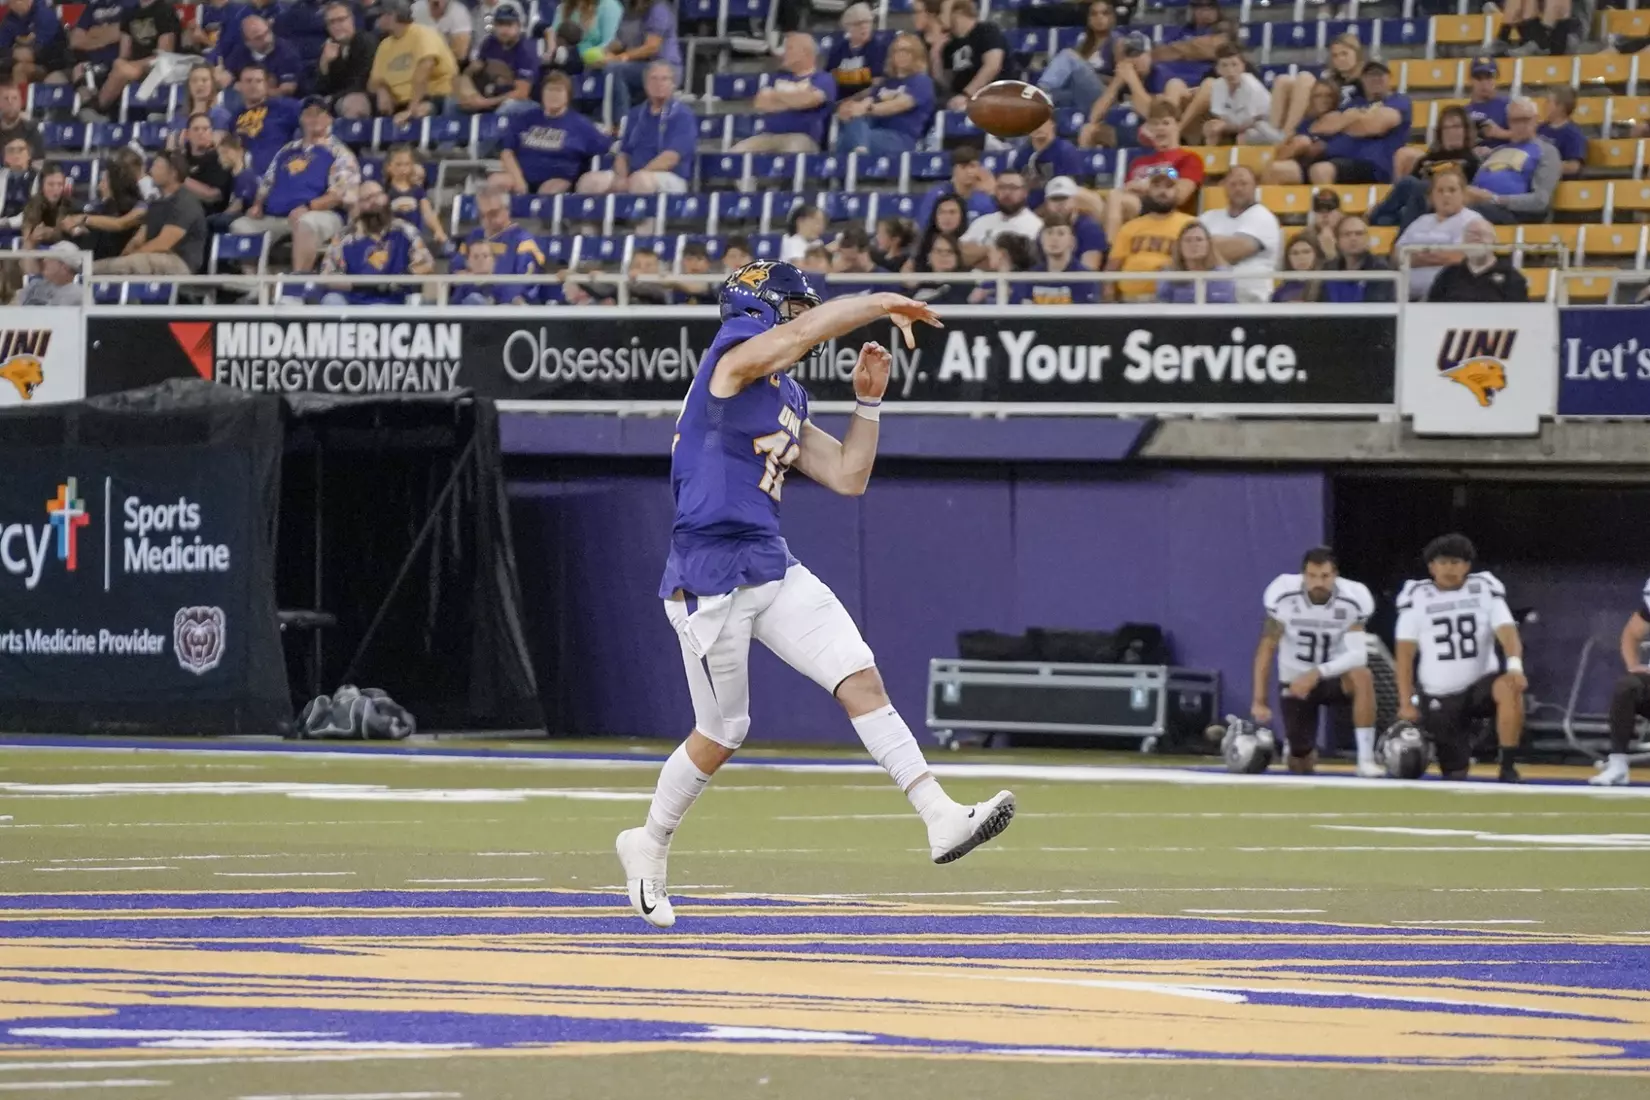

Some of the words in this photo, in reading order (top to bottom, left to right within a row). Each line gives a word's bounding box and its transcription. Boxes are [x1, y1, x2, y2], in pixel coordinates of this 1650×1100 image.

[215, 322, 463, 359] MIDAMERICAN
[938, 330, 991, 381] At
[999, 330, 1111, 382] Your
[1123, 326, 1308, 382] Service.
[1437, 329, 1518, 371] UNI
[216, 360, 314, 391] ENERGY
[323, 360, 462, 392] COMPANY
[123, 495, 202, 537] Sports
[0, 523, 51, 589] cy
[123, 535, 231, 573] Medicine
[24, 628, 97, 654] Medicine
[99, 628, 165, 655] Provider
[1295, 630, 1332, 664] 31
[1432, 613, 1478, 661] 38
